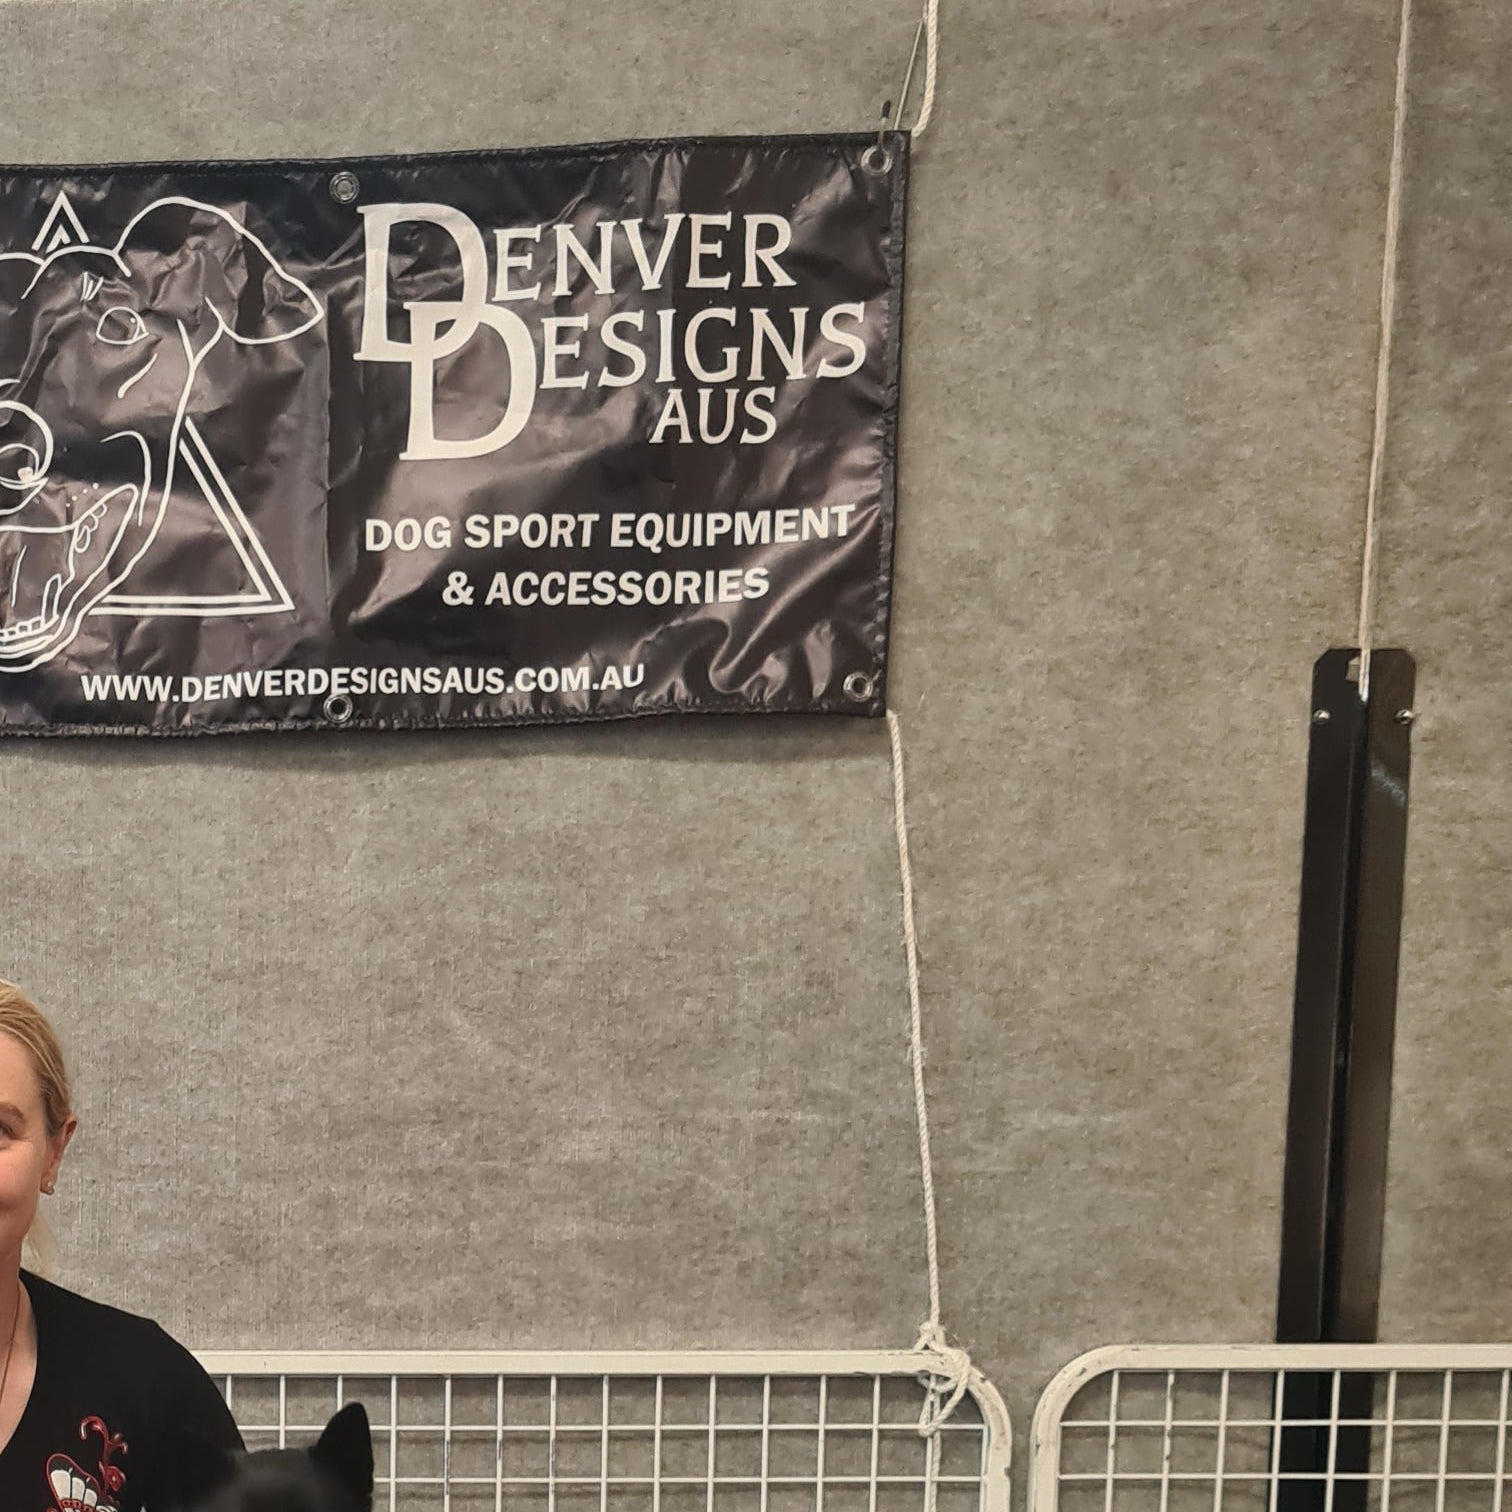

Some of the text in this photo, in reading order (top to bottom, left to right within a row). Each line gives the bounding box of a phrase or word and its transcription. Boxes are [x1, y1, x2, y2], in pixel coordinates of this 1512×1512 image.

[353, 203, 798, 361] DENVER
[399, 301, 867, 461] DESIGNS
[649, 385, 778, 445] AUS
[365, 504, 856, 554] DOG SPORT EQUIPMENT
[442, 567, 770, 607] & ACCESSORIES
[81, 663, 645, 704] WWW.DENVERDESIGNSAUS.COM.AU
